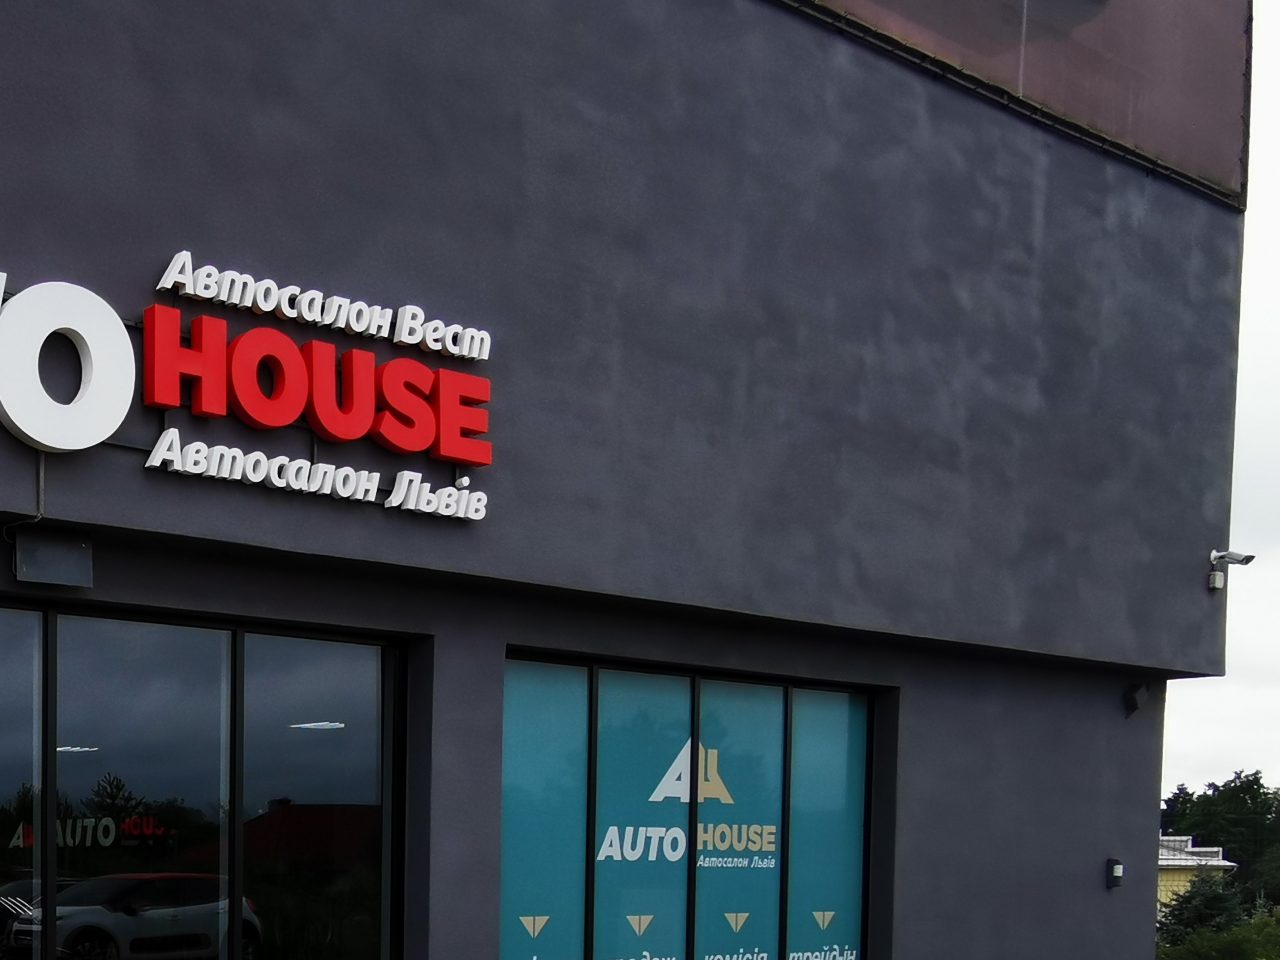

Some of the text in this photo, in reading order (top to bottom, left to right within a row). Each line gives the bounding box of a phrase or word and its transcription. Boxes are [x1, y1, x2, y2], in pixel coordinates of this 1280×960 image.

[156, 250, 491, 361] Автосалон Вест
[143, 303, 492, 465] HOUSE
[144, 427, 488, 520] Автосалон Львів
[597, 823, 776, 861] AUTO HOUSE
[697, 854, 776, 868] Автосалон Львів
